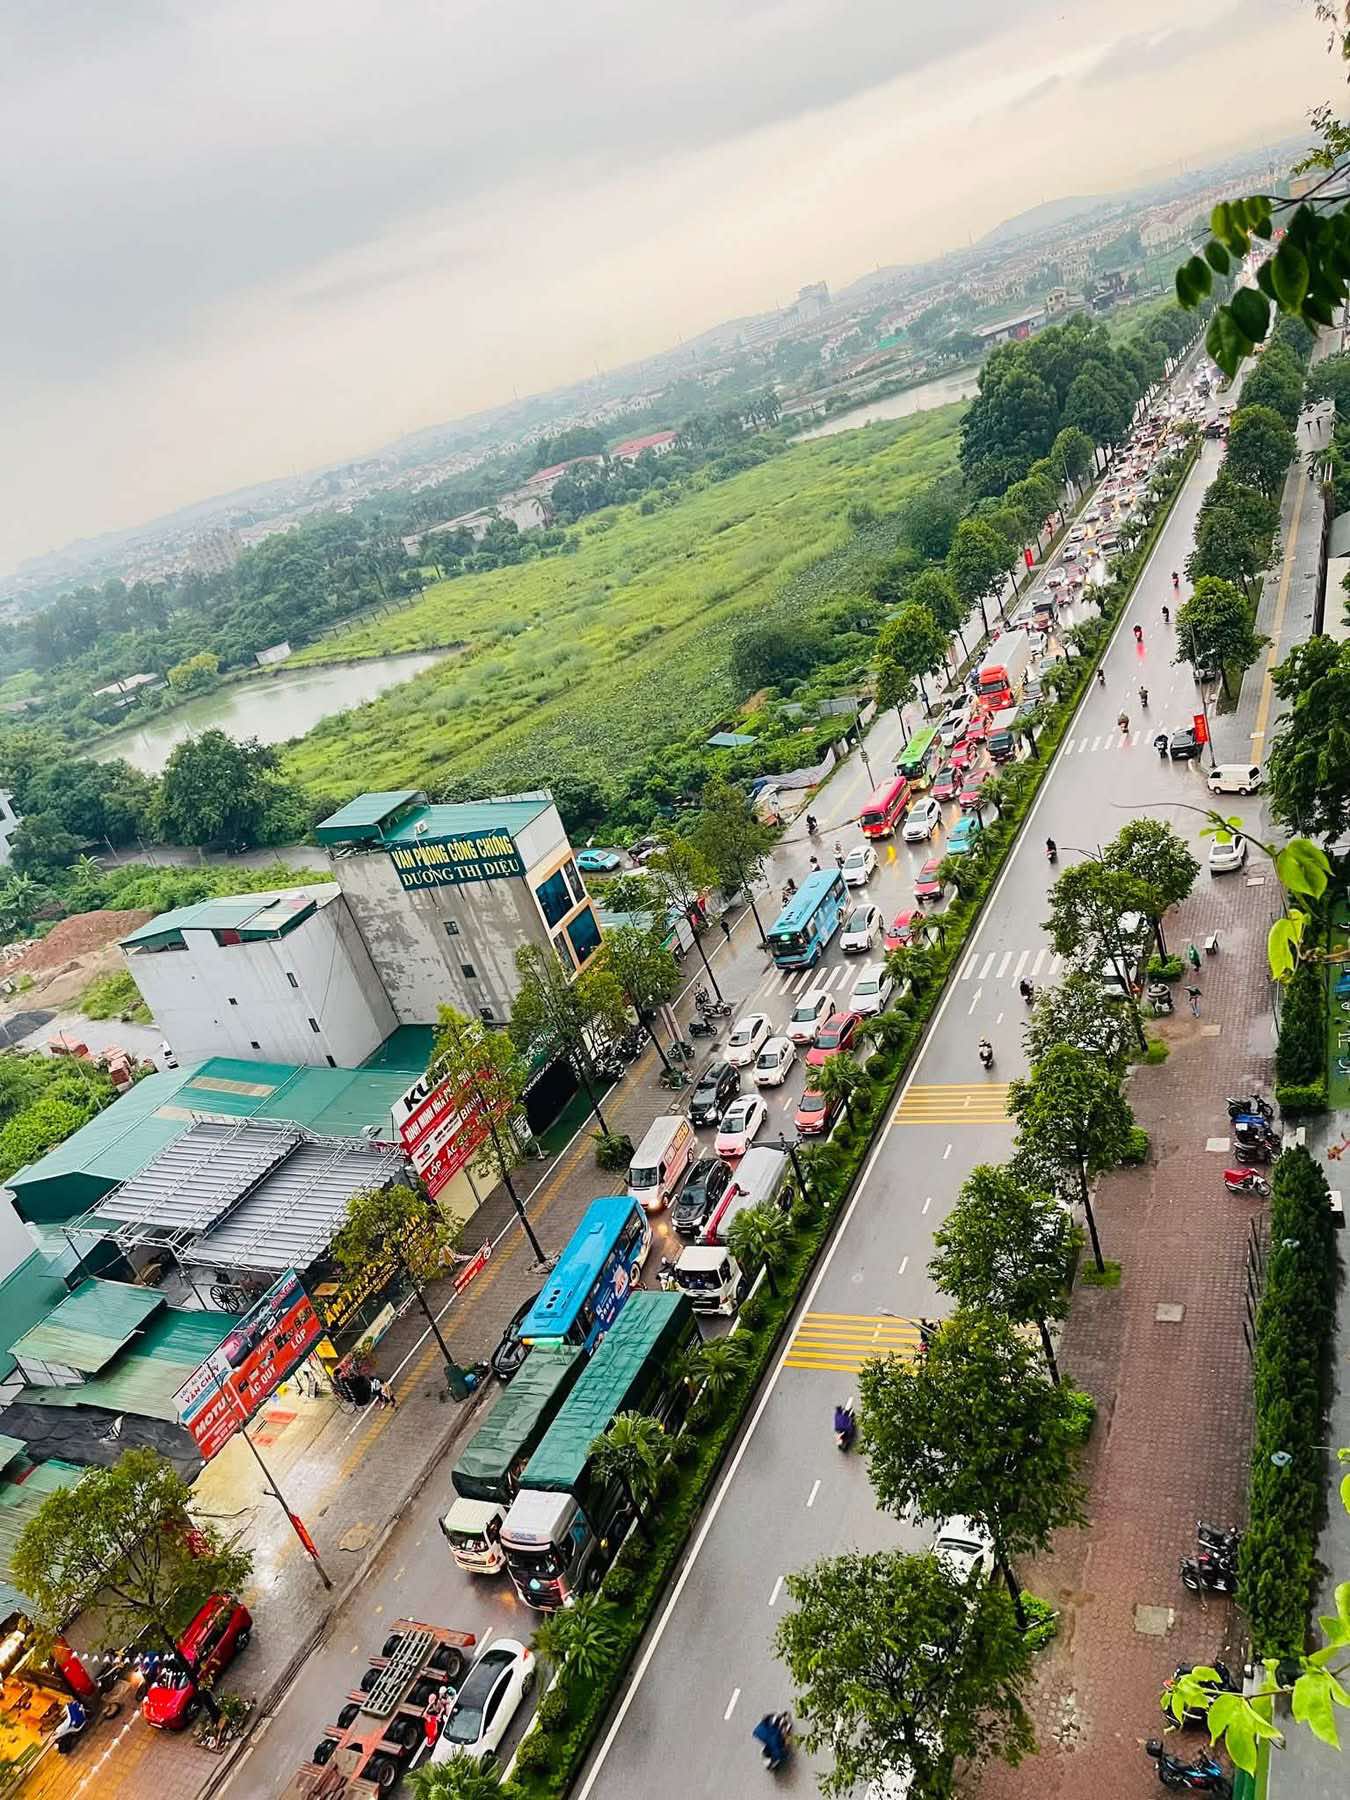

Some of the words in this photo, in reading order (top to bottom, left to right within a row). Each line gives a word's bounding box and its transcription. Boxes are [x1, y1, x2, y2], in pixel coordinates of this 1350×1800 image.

[391, 847, 416, 870] VĂN
[413, 841, 450, 866] PHÒNG
[447, 838, 478, 862] CÔNG
[476, 835, 514, 858] CHỨNG
[402, 868, 452, 886] DƯƠNG
[454, 863, 483, 880] THỊ
[482, 858, 520, 876] DIỆU
[193, 1390, 232, 1438] MOTUL
